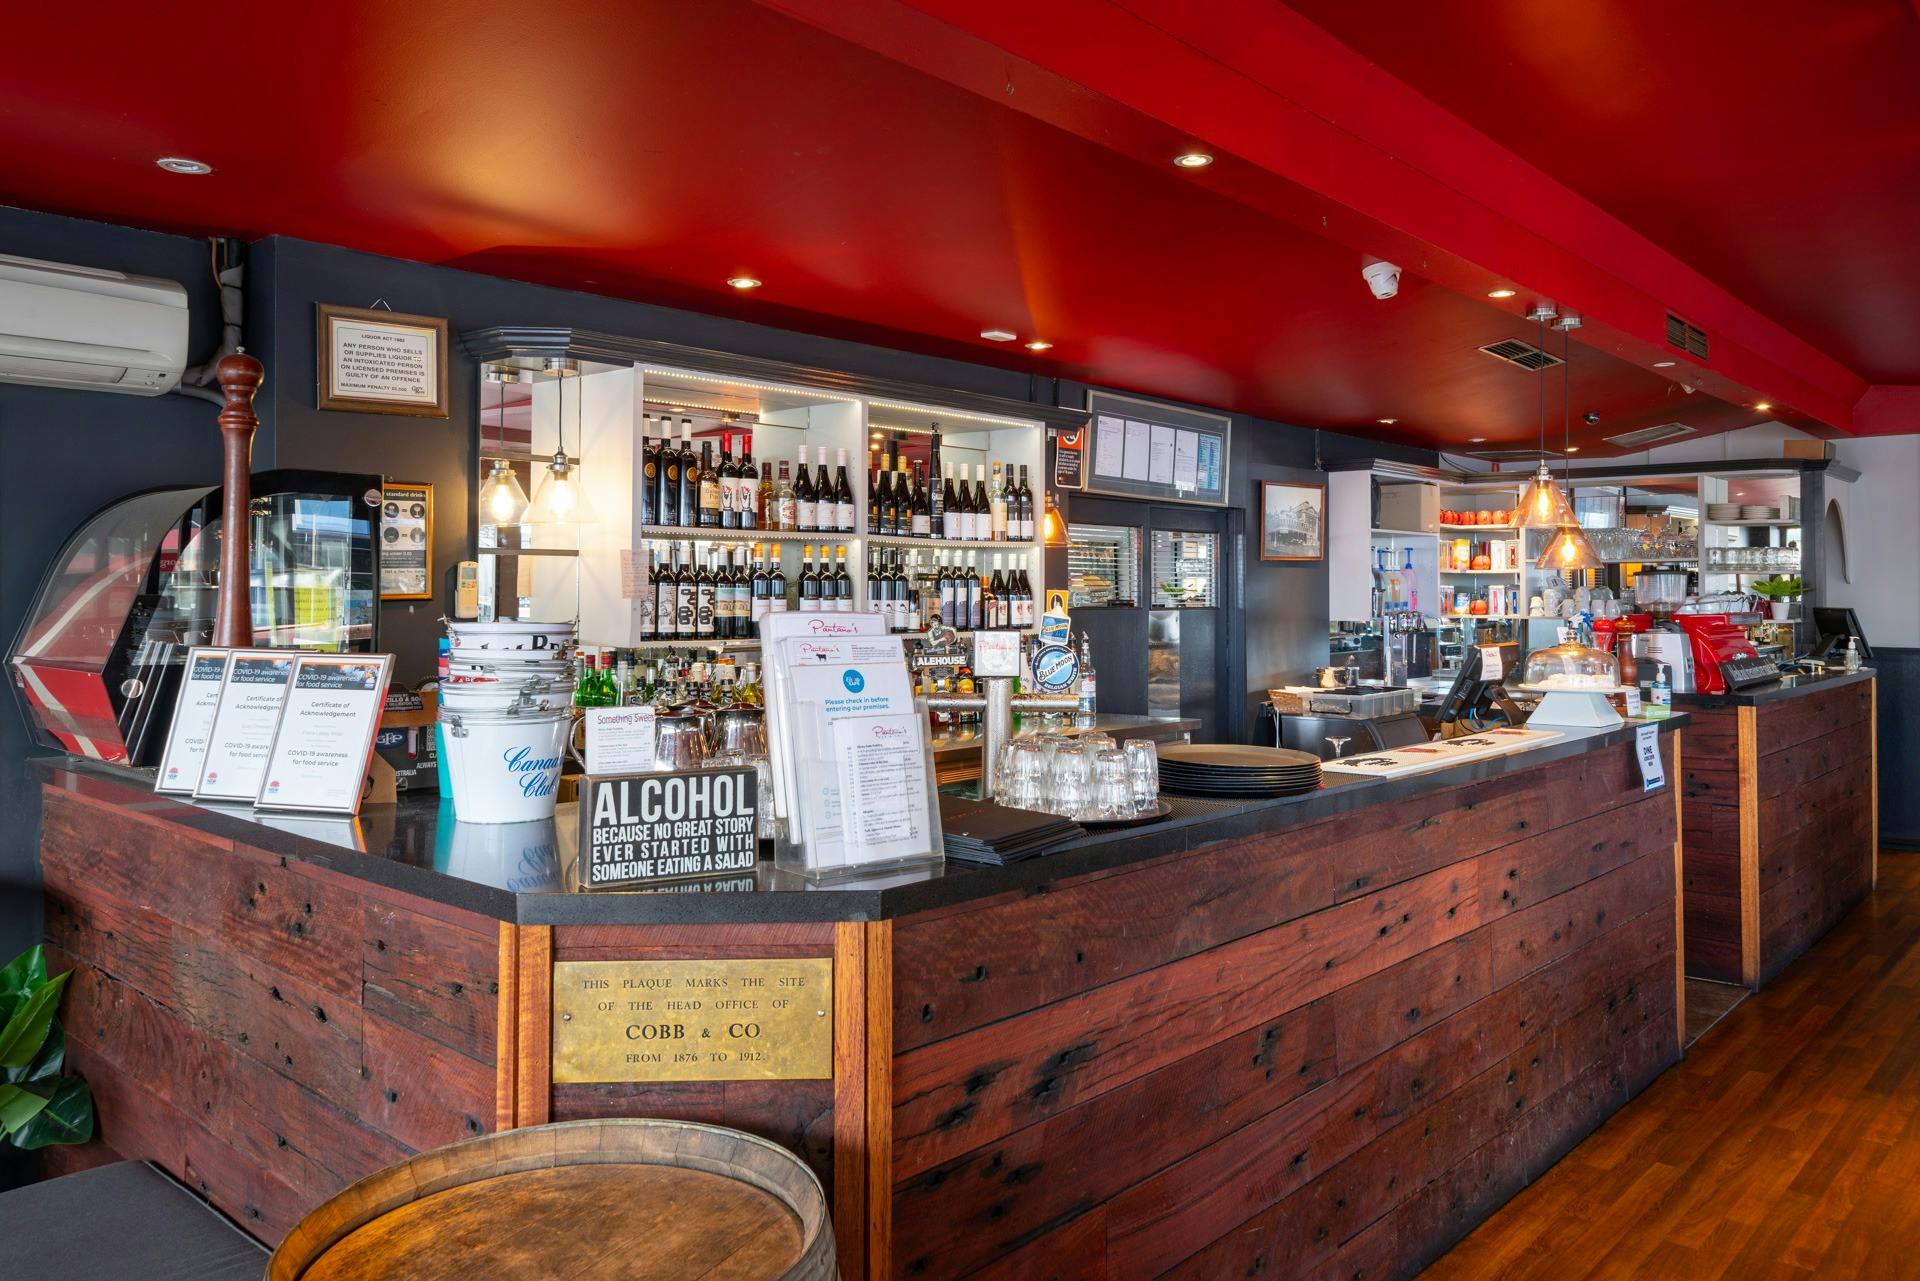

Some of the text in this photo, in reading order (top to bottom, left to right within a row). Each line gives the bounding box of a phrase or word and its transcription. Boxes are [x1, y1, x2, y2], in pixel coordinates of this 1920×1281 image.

[358, 344, 385, 352] PERSON
[355, 351, 386, 359] SUPPLIES
[354, 358, 396, 367] INTOXICATED
[916, 655, 966, 666] ALEHOUSE
[193, 666, 221, 674] COVID-19
[233, 667, 260, 675] COVID-19
[1039, 656, 1073, 681] BLUE MOON
[300, 710, 356, 718] Acknowledgement
[598, 714, 632, 725] Something
[593, 774, 753, 827] ALCOHOL
[593, 816, 754, 845] BECAUSE NO GREAT STORY
[593, 834, 754, 864] EVER STARTED WITH
[593, 851, 754, 882] SOMEONE EATING A SALAD
[583, 976, 805, 990] THIS PLAQUE MARKS THE SITE
[598, 999, 789, 1011] OF THE HEAD OFFICE OF
[626, 1023, 760, 1040] COBB & CO
[626, 1054, 661, 1063] FROM
[673, 1052, 698, 1062] 1876
[710, 1052, 727, 1062] TO
